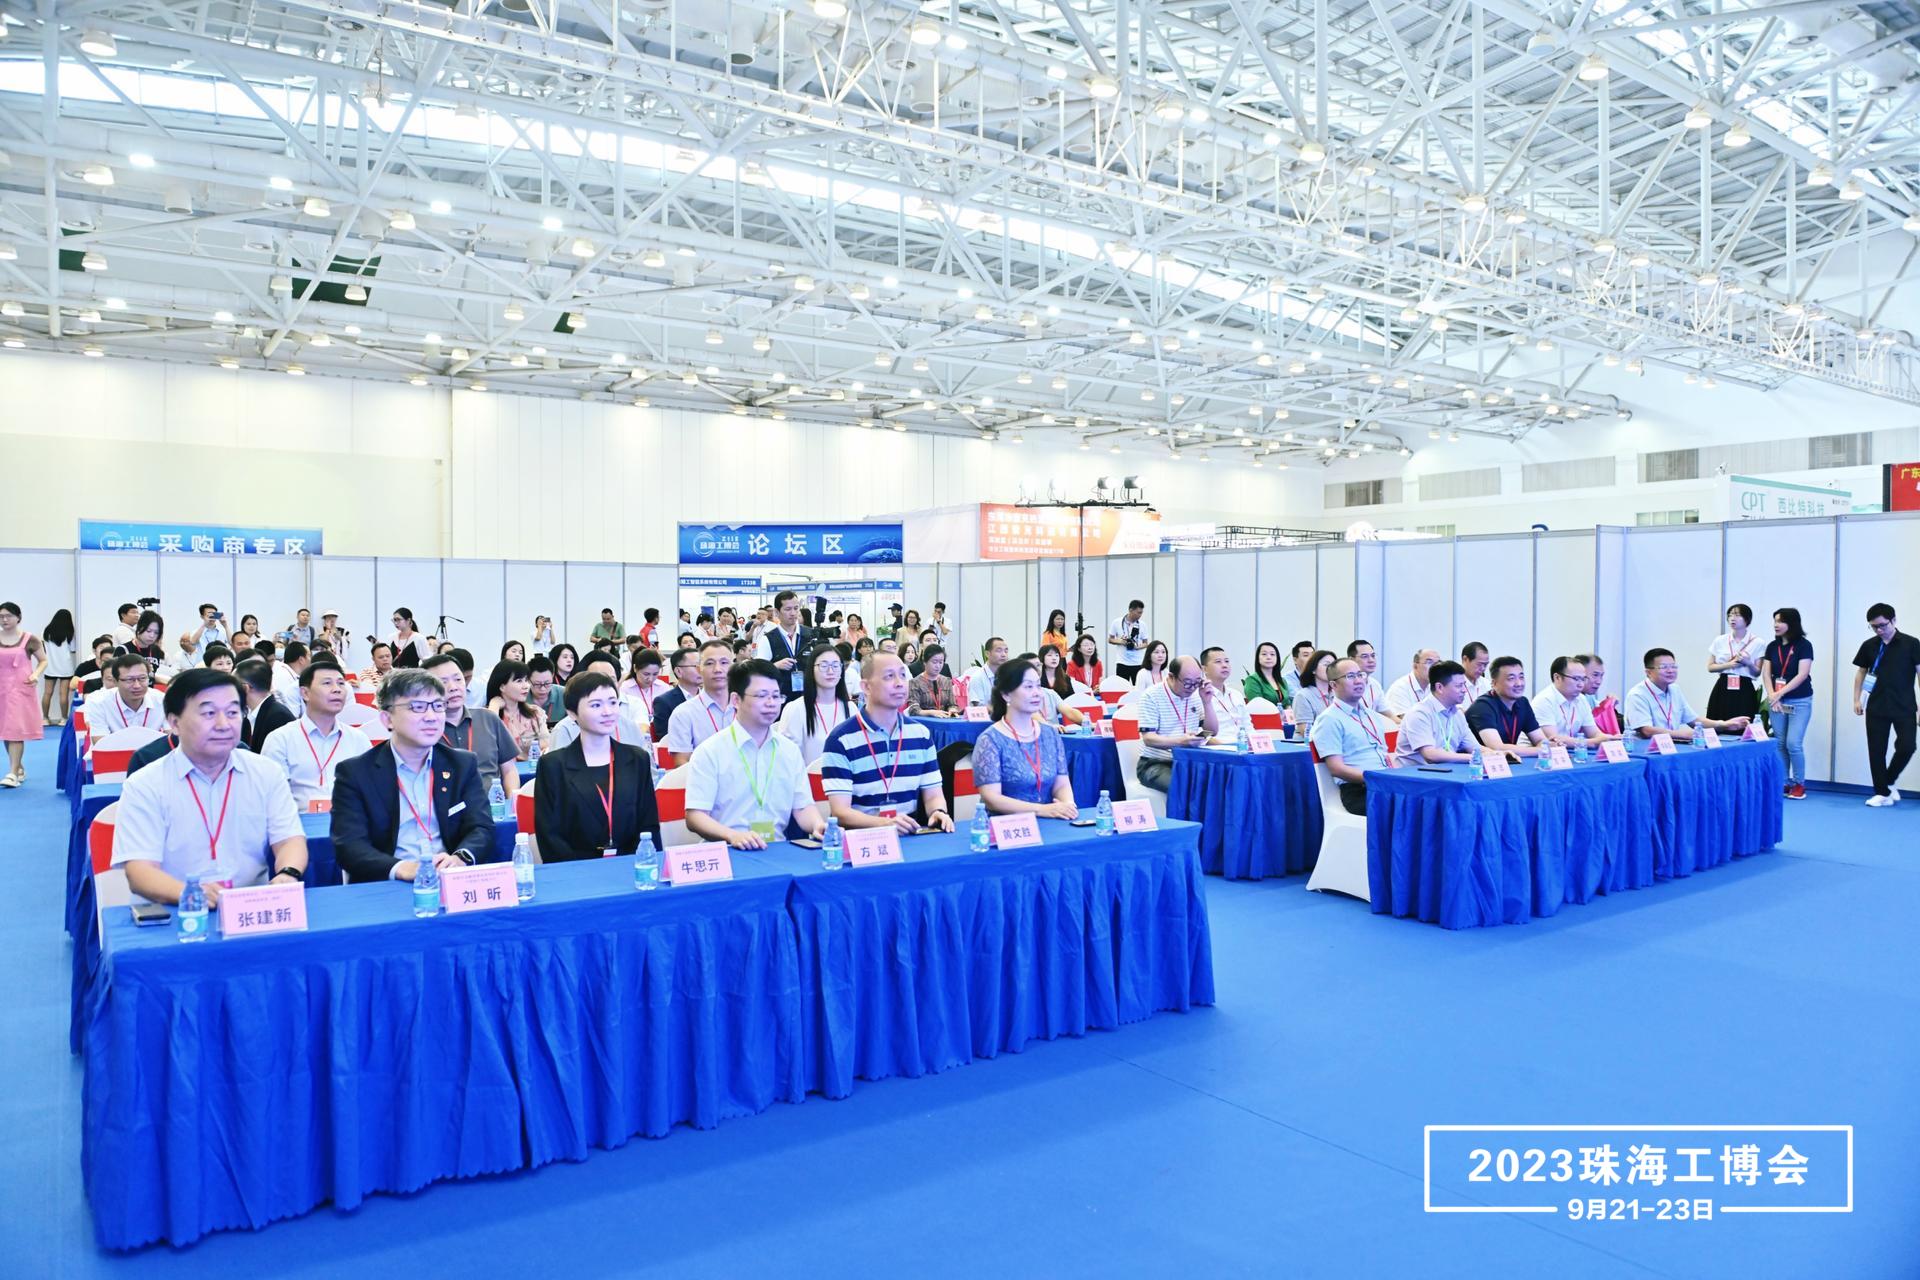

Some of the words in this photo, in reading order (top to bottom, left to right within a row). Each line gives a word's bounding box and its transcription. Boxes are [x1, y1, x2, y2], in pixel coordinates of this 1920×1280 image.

[1741, 491, 1766, 513] CPT
[158, 534, 306, 555] 采购商专区
[748, 533, 844, 556] 论坛区
[462, 886, 502, 904] 刘昕
[238, 907, 292, 928] 张建新
